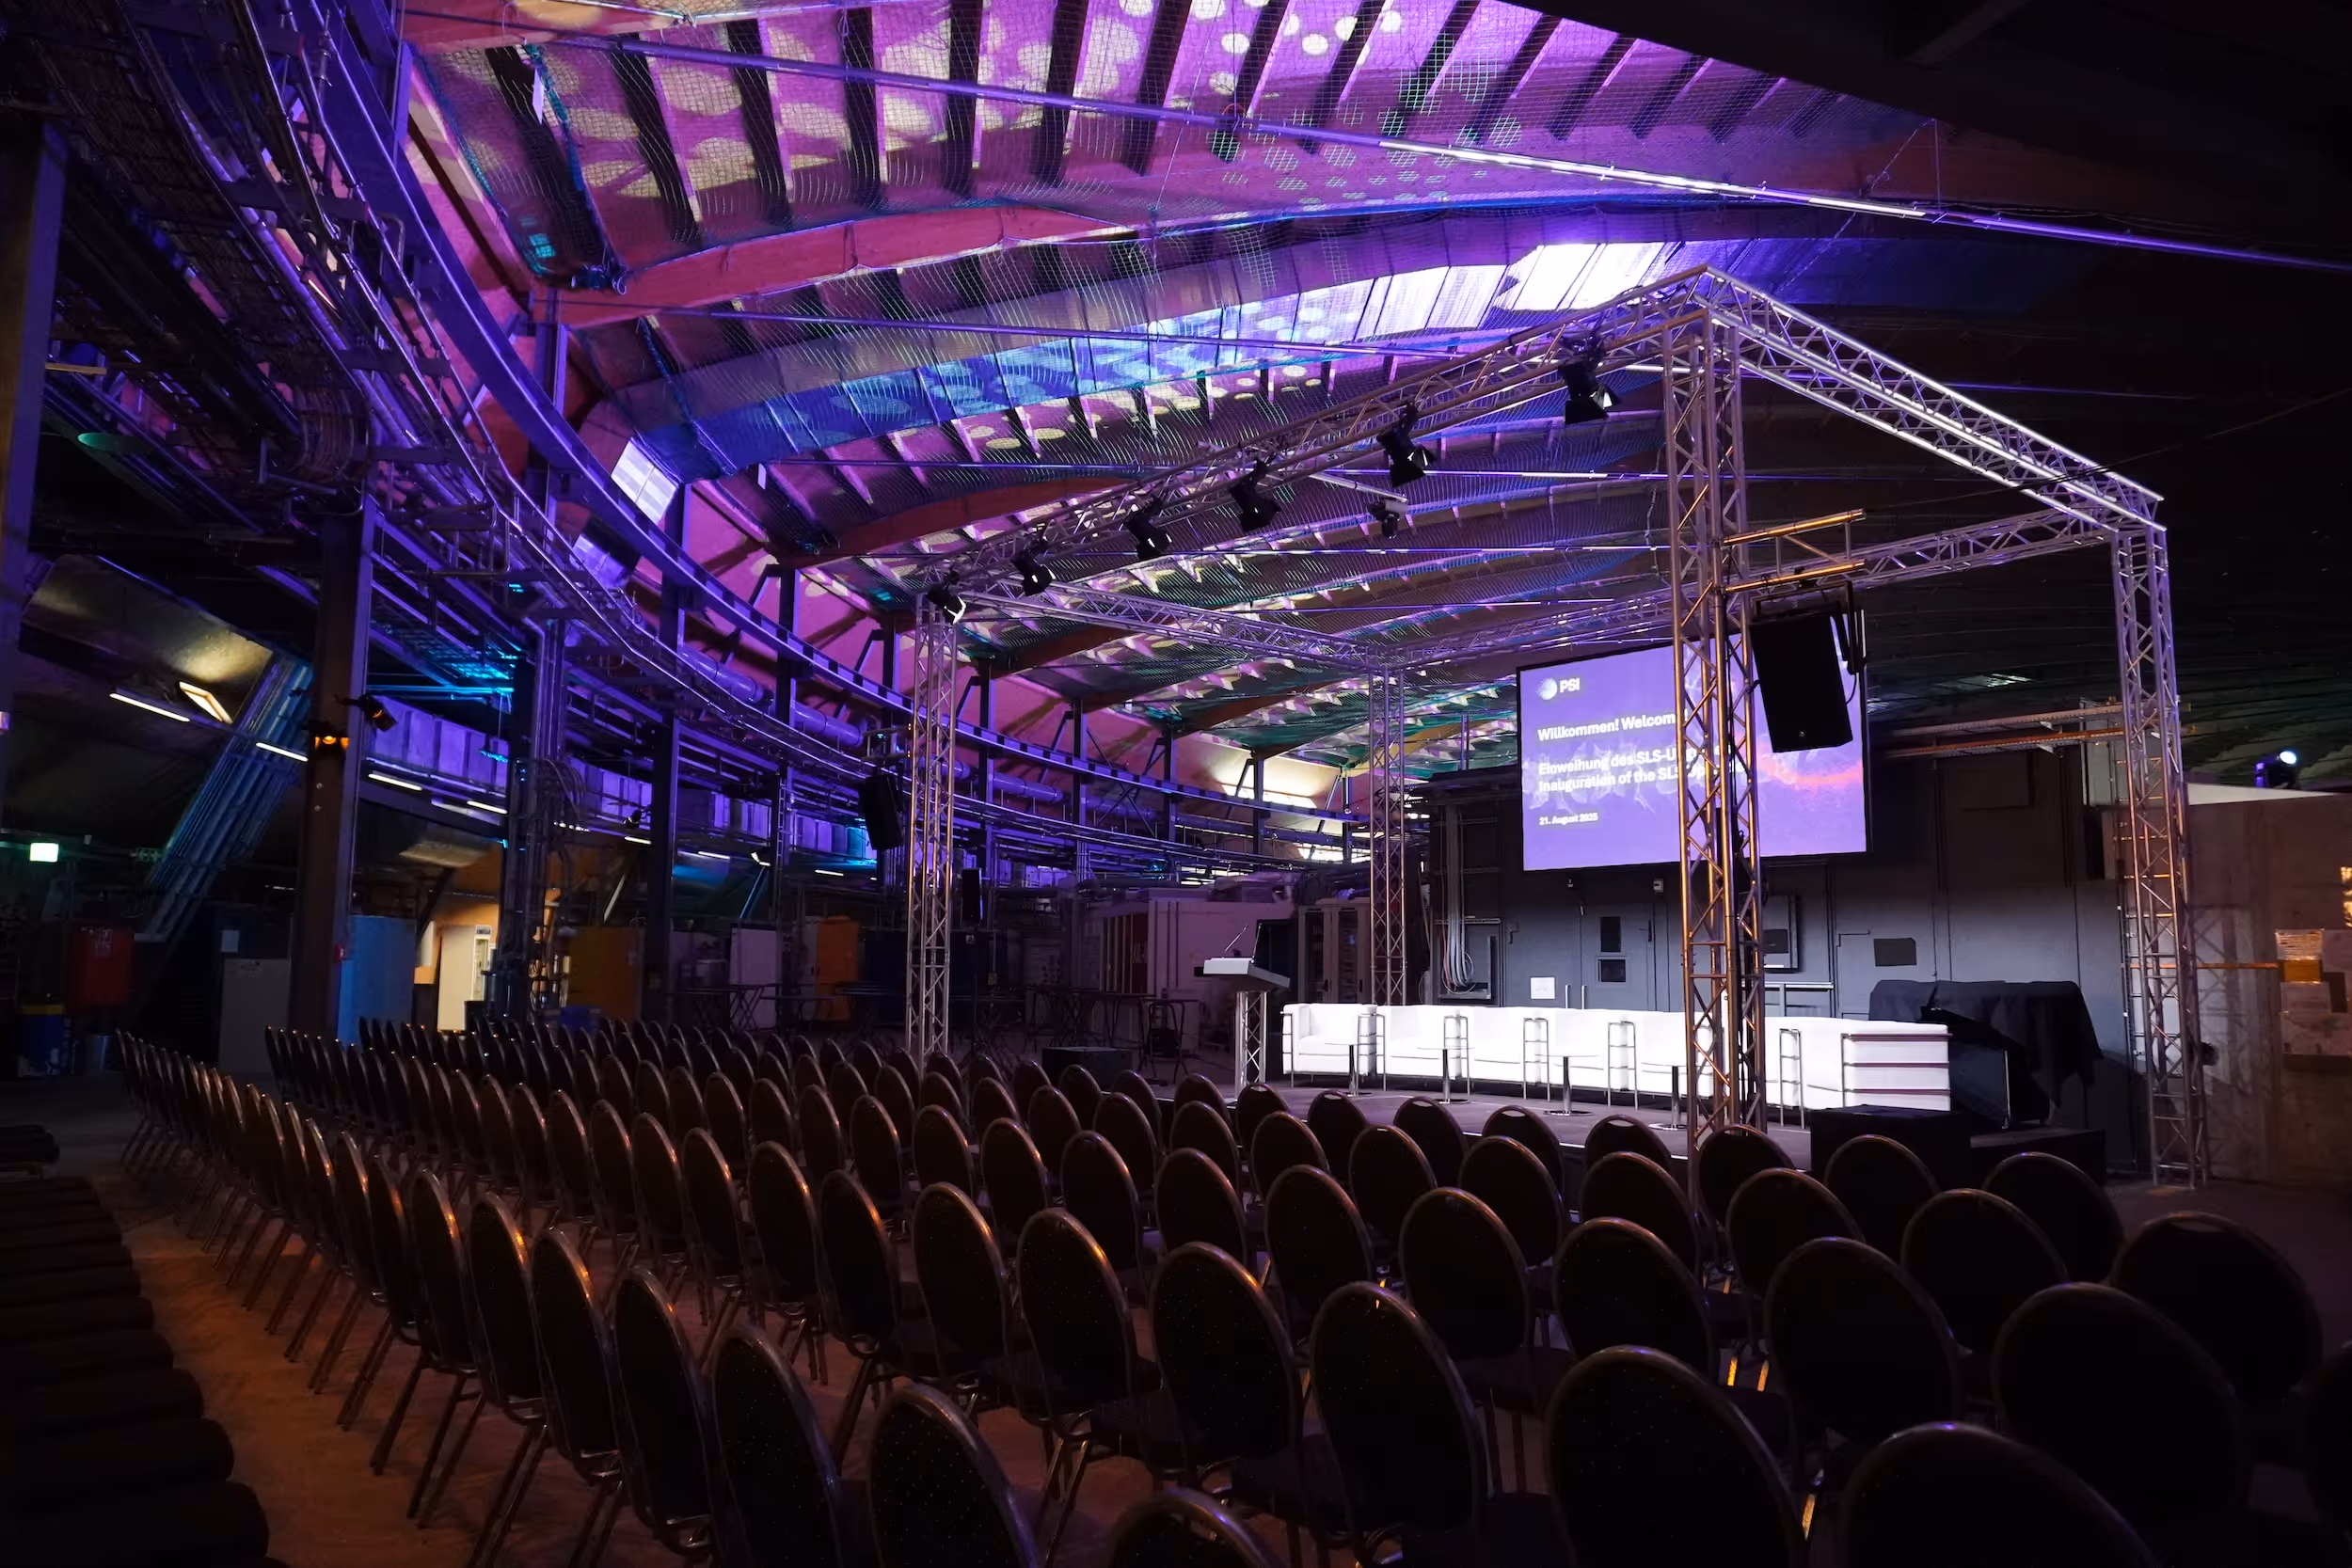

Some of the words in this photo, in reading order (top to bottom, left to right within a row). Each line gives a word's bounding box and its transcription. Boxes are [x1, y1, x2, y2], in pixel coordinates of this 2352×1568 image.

[1560, 677, 1581, 693] PSI
[1537, 718, 1620, 741] Willkommen!
[1621, 708, 1689, 730] Welcom!
[1539, 756, 1610, 775] Einweihung
[1611, 753, 1635, 768] des
[1539, 774, 1616, 793] Inauguration
[1618, 770, 1633, 784] of
[1633, 769, 1656, 784] the
[1538, 816, 1551, 826] 21.
[1551, 814, 1579, 826] August
[1579, 812, 1599, 823] 2025
